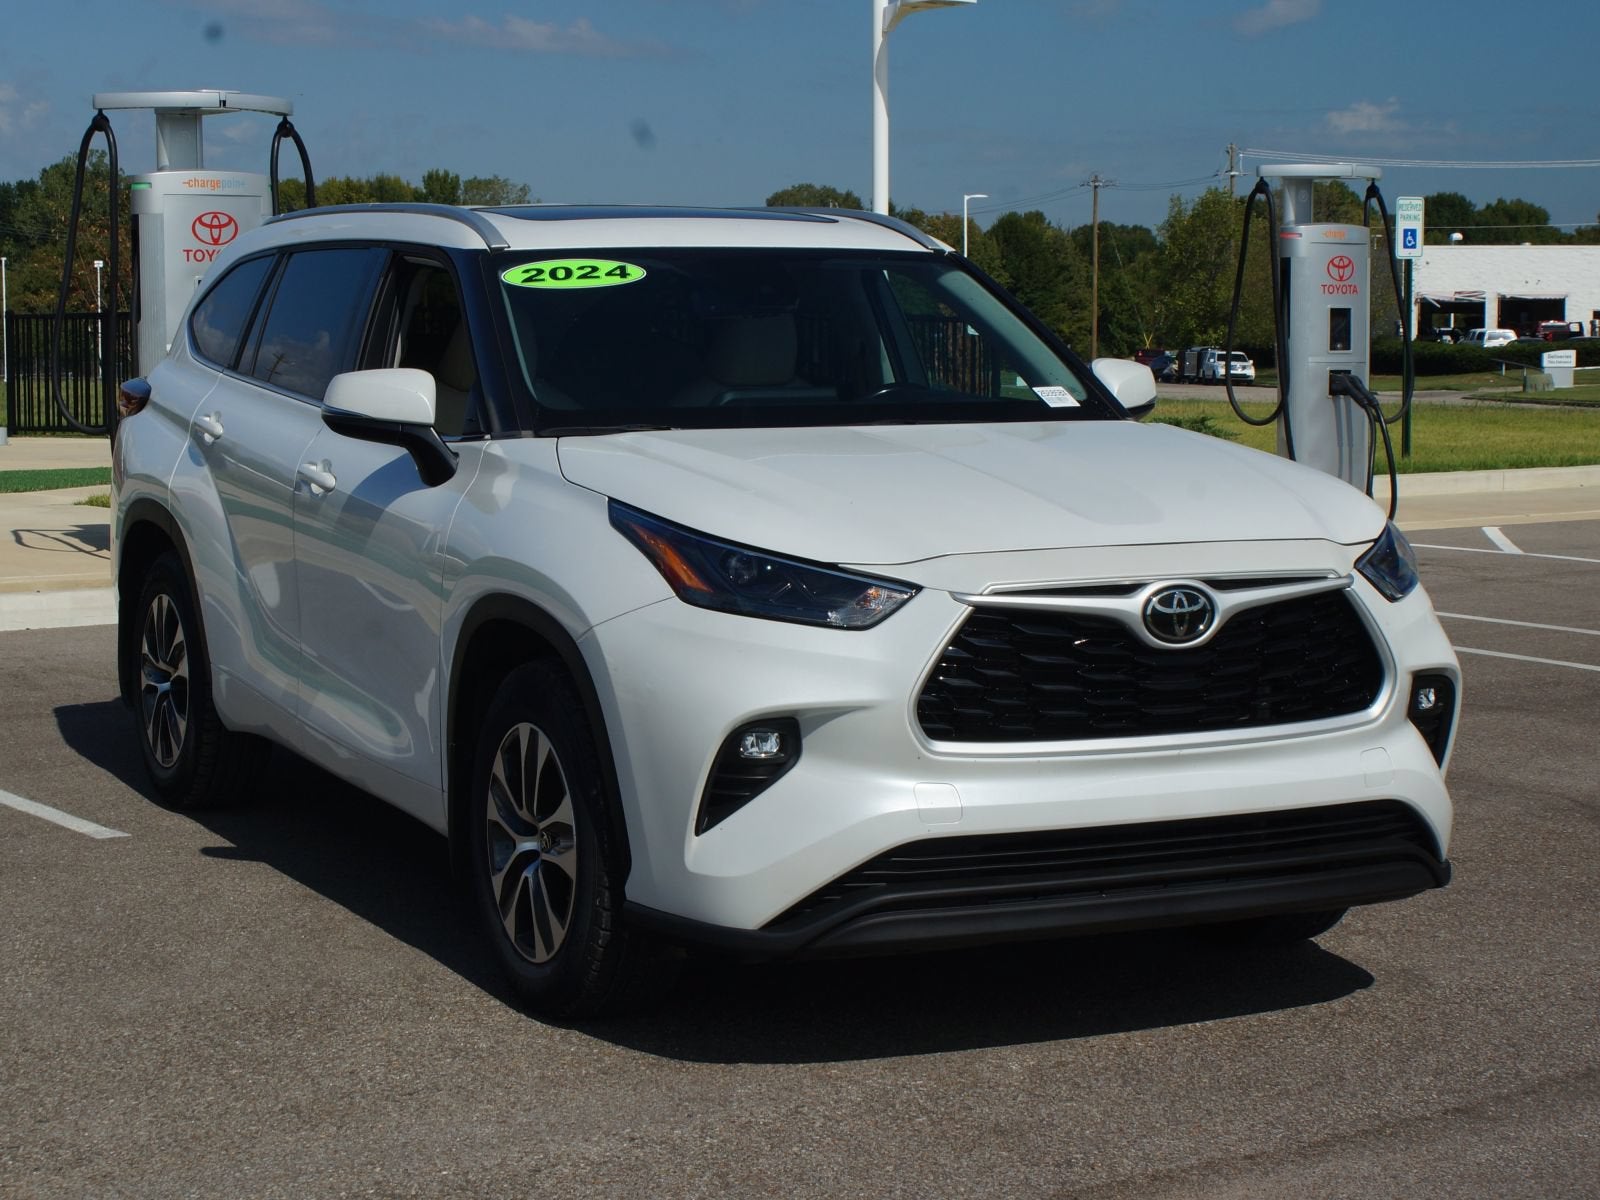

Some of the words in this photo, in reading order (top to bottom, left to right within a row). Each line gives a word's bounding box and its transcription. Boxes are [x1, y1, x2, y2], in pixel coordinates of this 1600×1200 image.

[183, 249, 221, 263] TOY
[521, 264, 631, 283] 2024
[1320, 284, 1358, 295] TOYOTA
